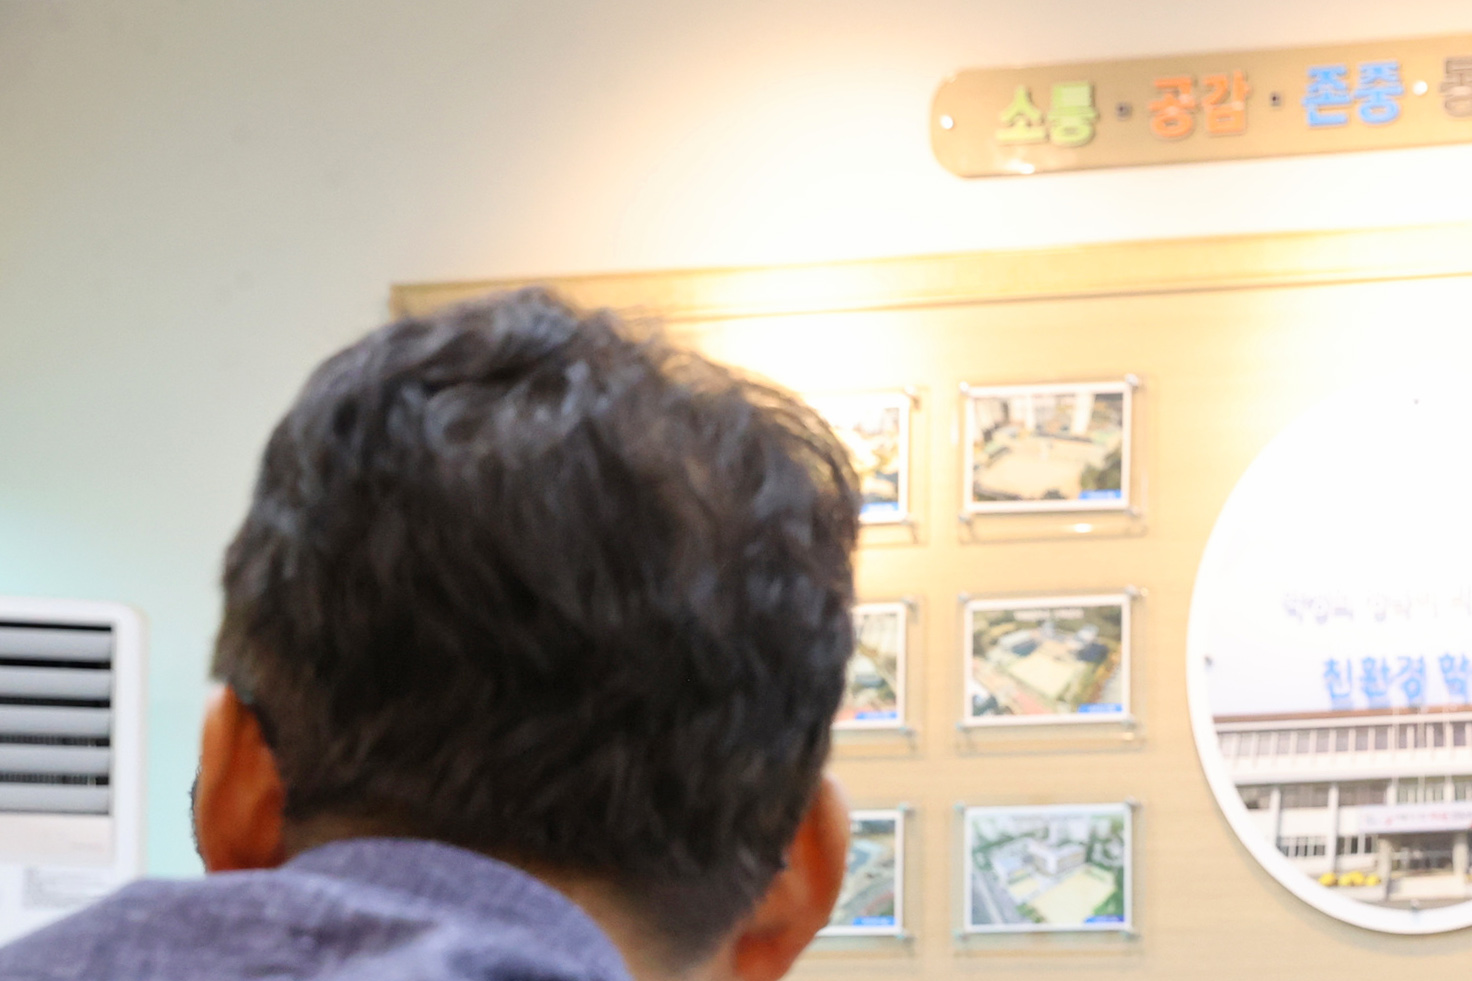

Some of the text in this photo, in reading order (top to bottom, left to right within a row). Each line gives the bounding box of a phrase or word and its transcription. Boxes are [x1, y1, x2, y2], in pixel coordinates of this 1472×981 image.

[995, 79, 1098, 147] 소통
[1149, 70, 1251, 140] 공감
[1302, 60, 1404, 128] 존중
[1323, 655, 1427, 707] 친환경
